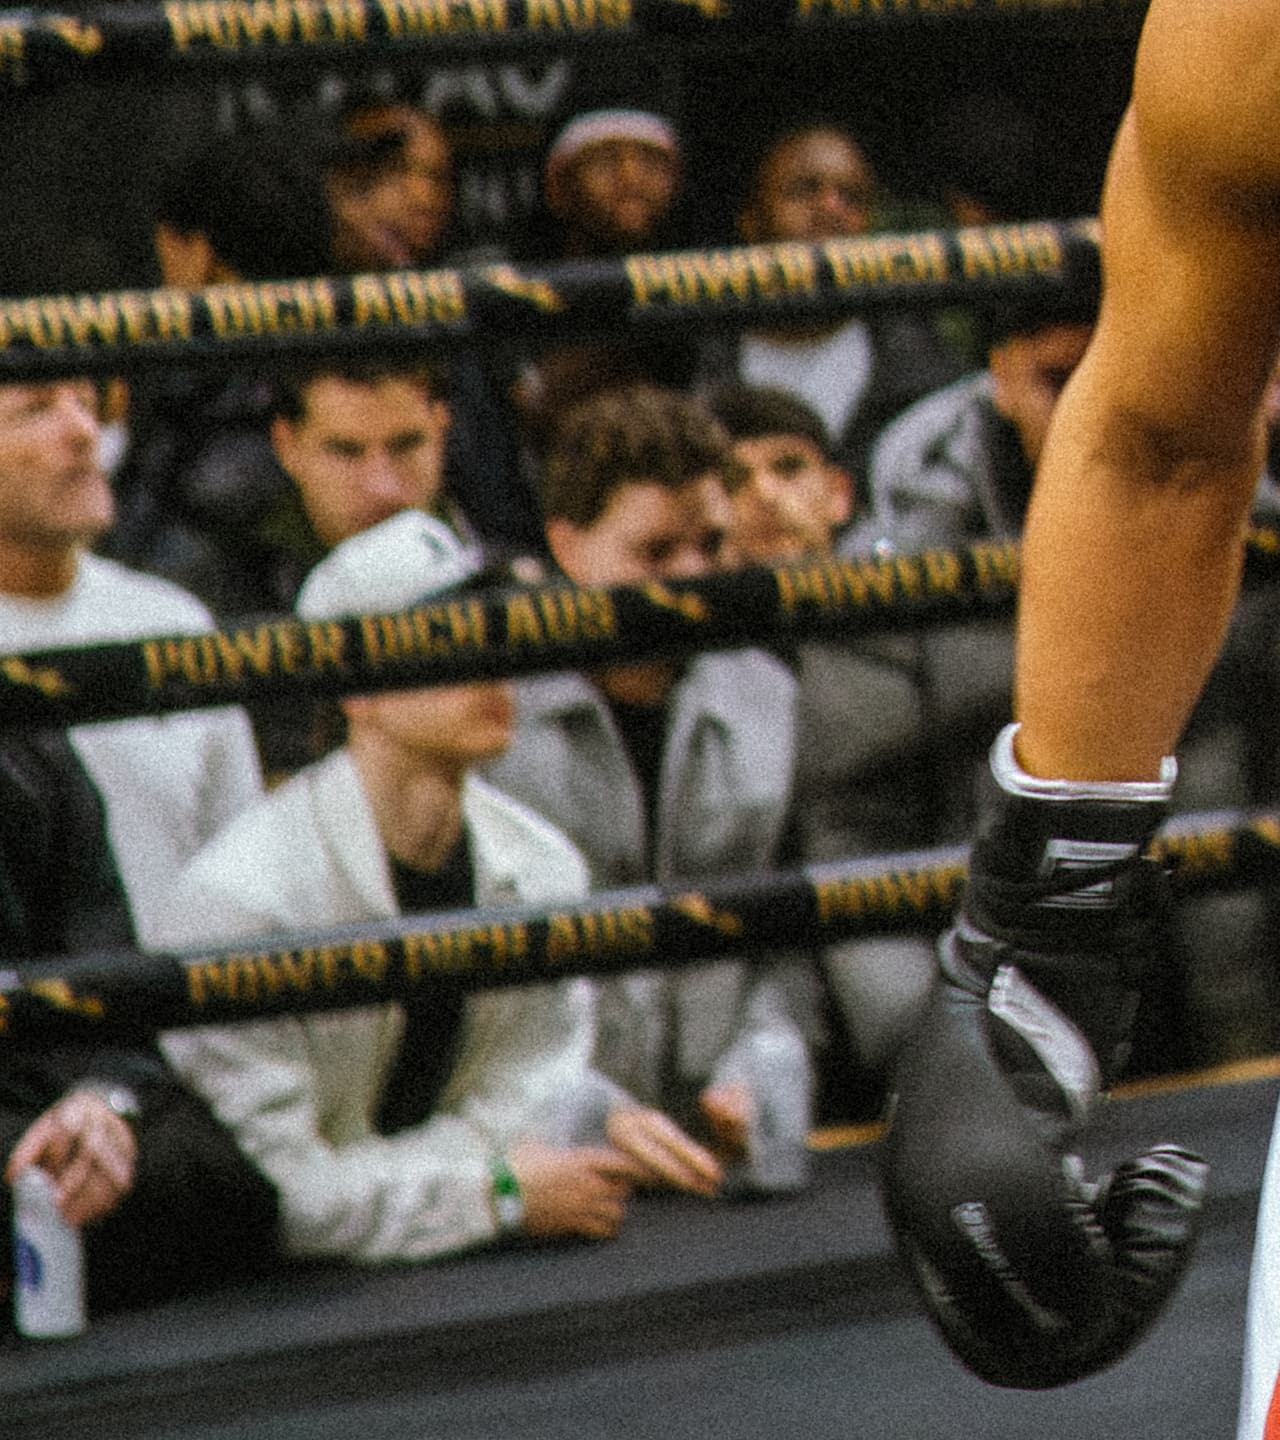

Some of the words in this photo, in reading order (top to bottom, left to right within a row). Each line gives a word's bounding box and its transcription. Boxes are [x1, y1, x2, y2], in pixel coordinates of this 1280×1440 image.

[144, 623, 346, 689] POWER
[360, 599, 487, 665] DICH
[504, 581, 617, 641] AUS
